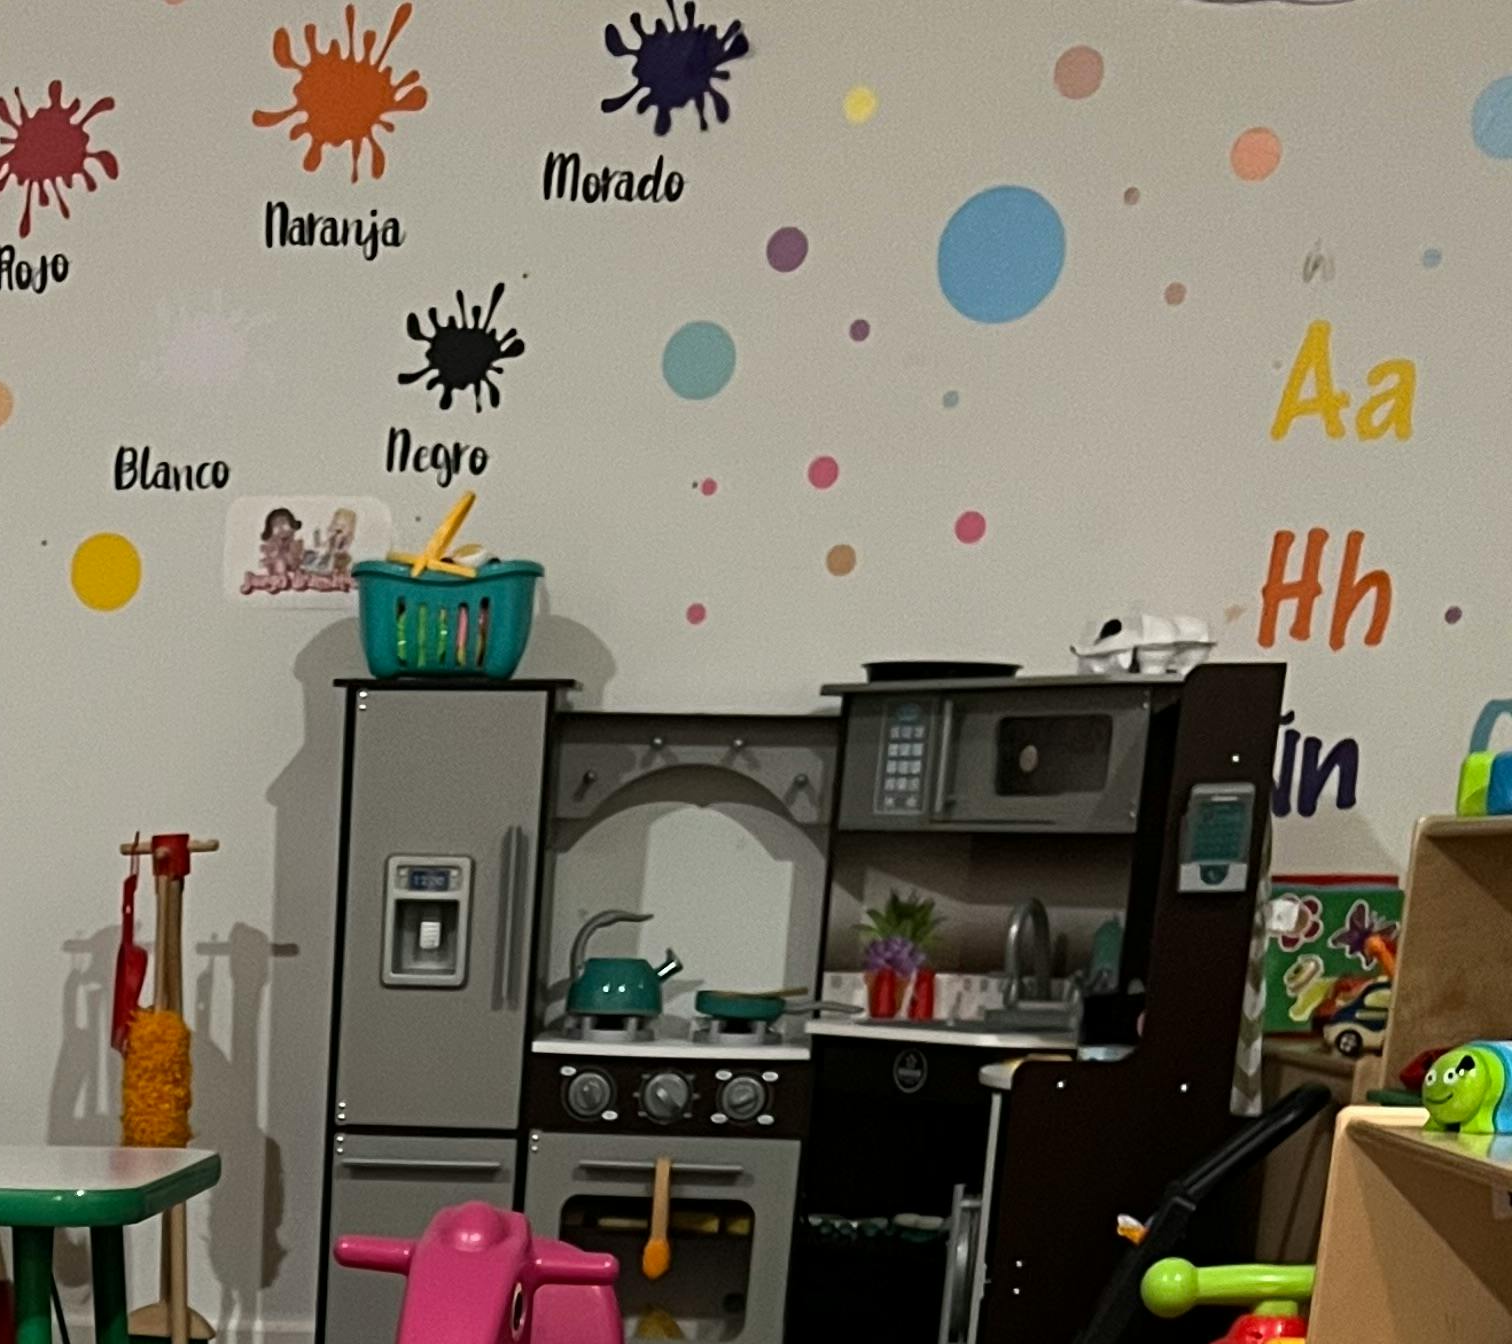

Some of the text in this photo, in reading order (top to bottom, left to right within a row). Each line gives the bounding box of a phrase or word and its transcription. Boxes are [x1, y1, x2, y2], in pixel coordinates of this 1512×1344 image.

[541, 151, 686, 205] Morado
[264, 200, 406, 261] Naranja
[1269, 319, 1418, 443] Aa
[112, 445, 231, 491] Blanco
[385, 427, 491, 487] Negro
[1256, 527, 1392, 652] Hh
